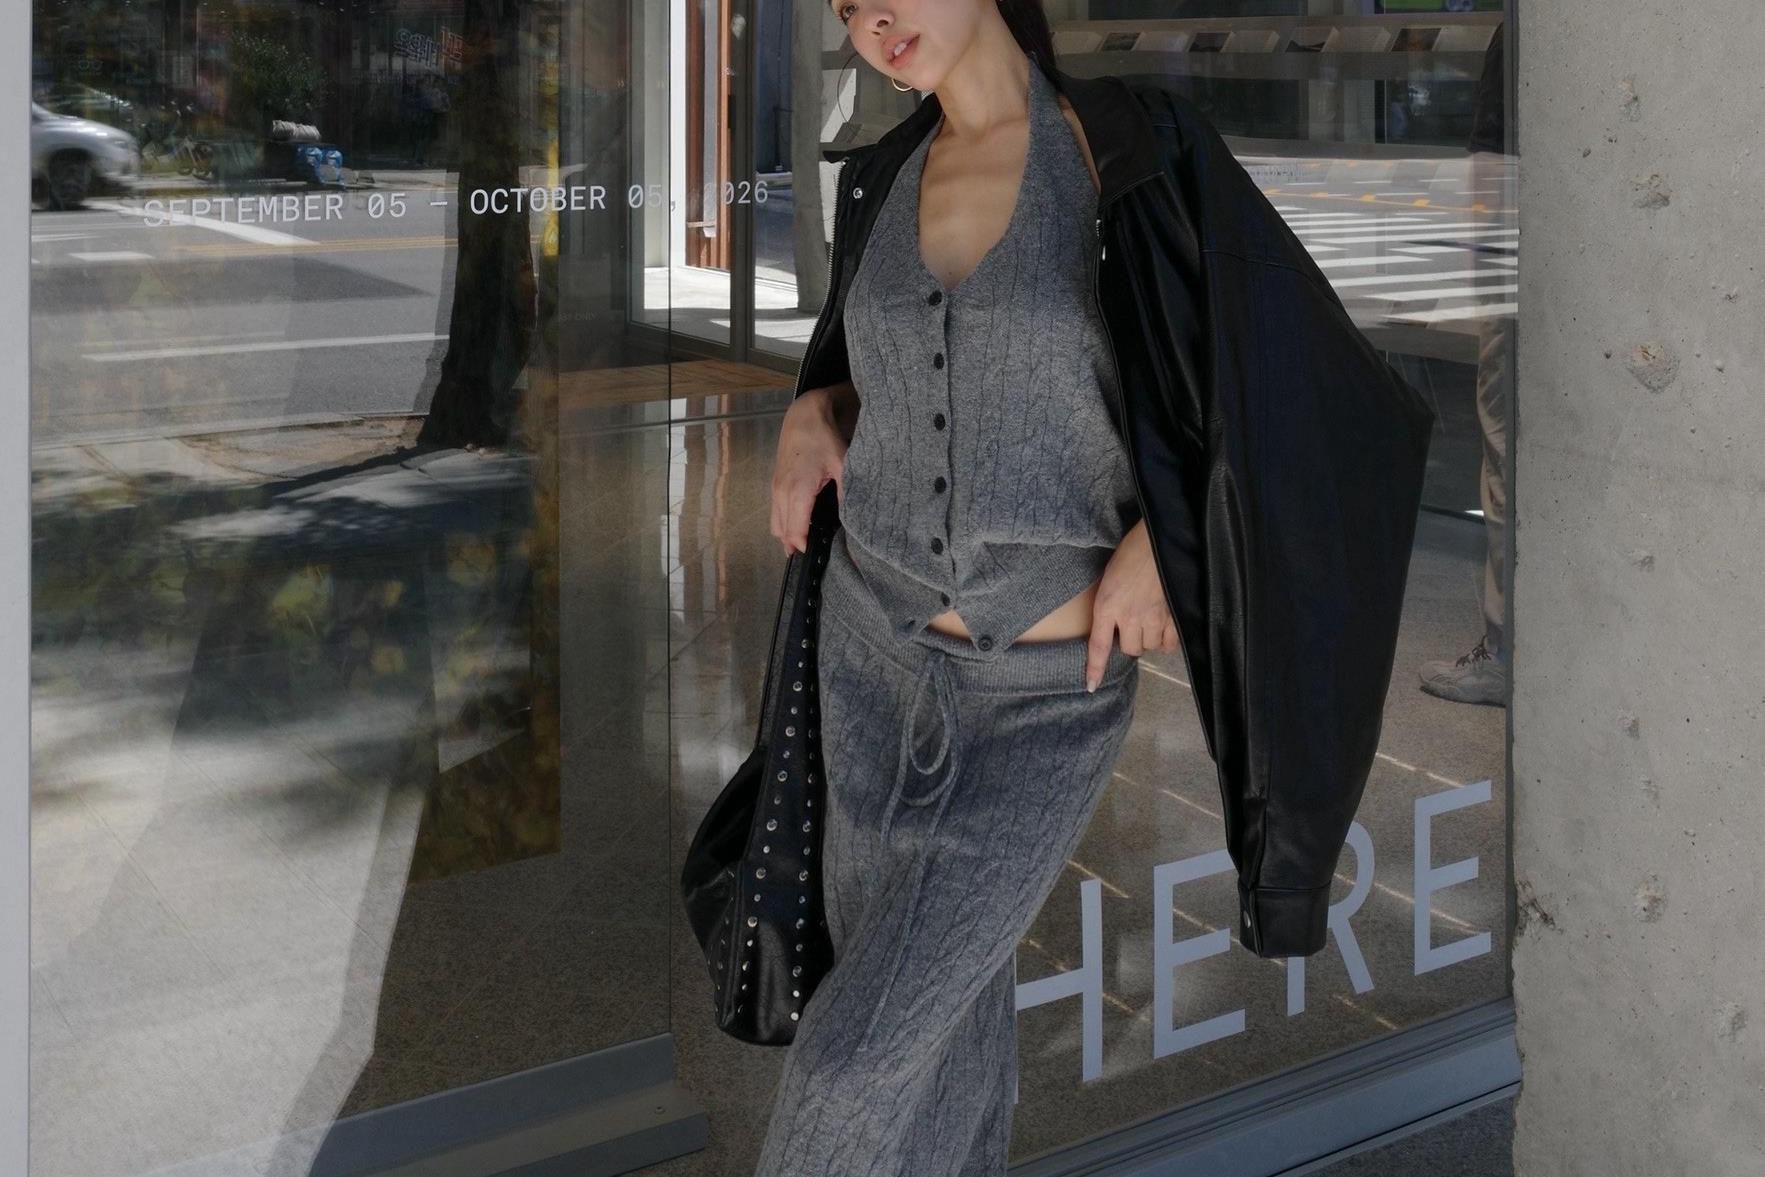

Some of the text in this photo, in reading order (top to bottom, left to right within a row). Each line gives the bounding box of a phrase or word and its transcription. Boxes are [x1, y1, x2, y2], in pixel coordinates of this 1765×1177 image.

[143, 193, 343, 227] SEPTEMBER
[367, 193, 407, 219] 05
[469, 185, 607, 215] OCTOBER
[704, 180, 768, 205] 026
